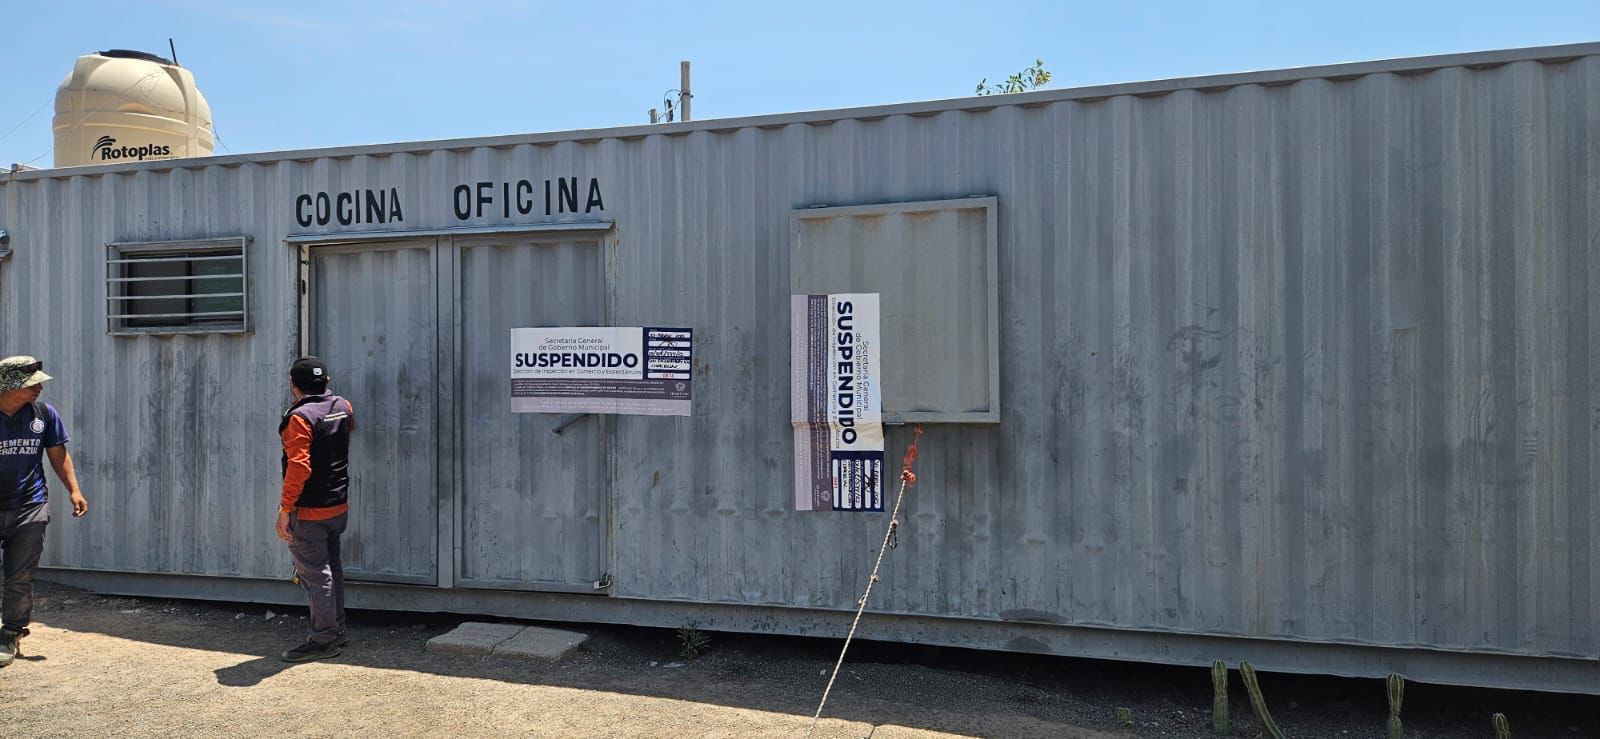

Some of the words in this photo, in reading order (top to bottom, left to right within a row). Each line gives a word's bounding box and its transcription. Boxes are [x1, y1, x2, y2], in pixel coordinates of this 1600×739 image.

[101, 143, 170, 160] Rotoplas
[295, 187, 403, 227] COCINA
[453, 176, 605, 221] OFICINA
[856, 332, 861, 342] de
[515, 352, 639, 368] SUSPENDIDO
[837, 301, 857, 444] SUSPENDIDO
[0, 447, 17, 456] RUZ
